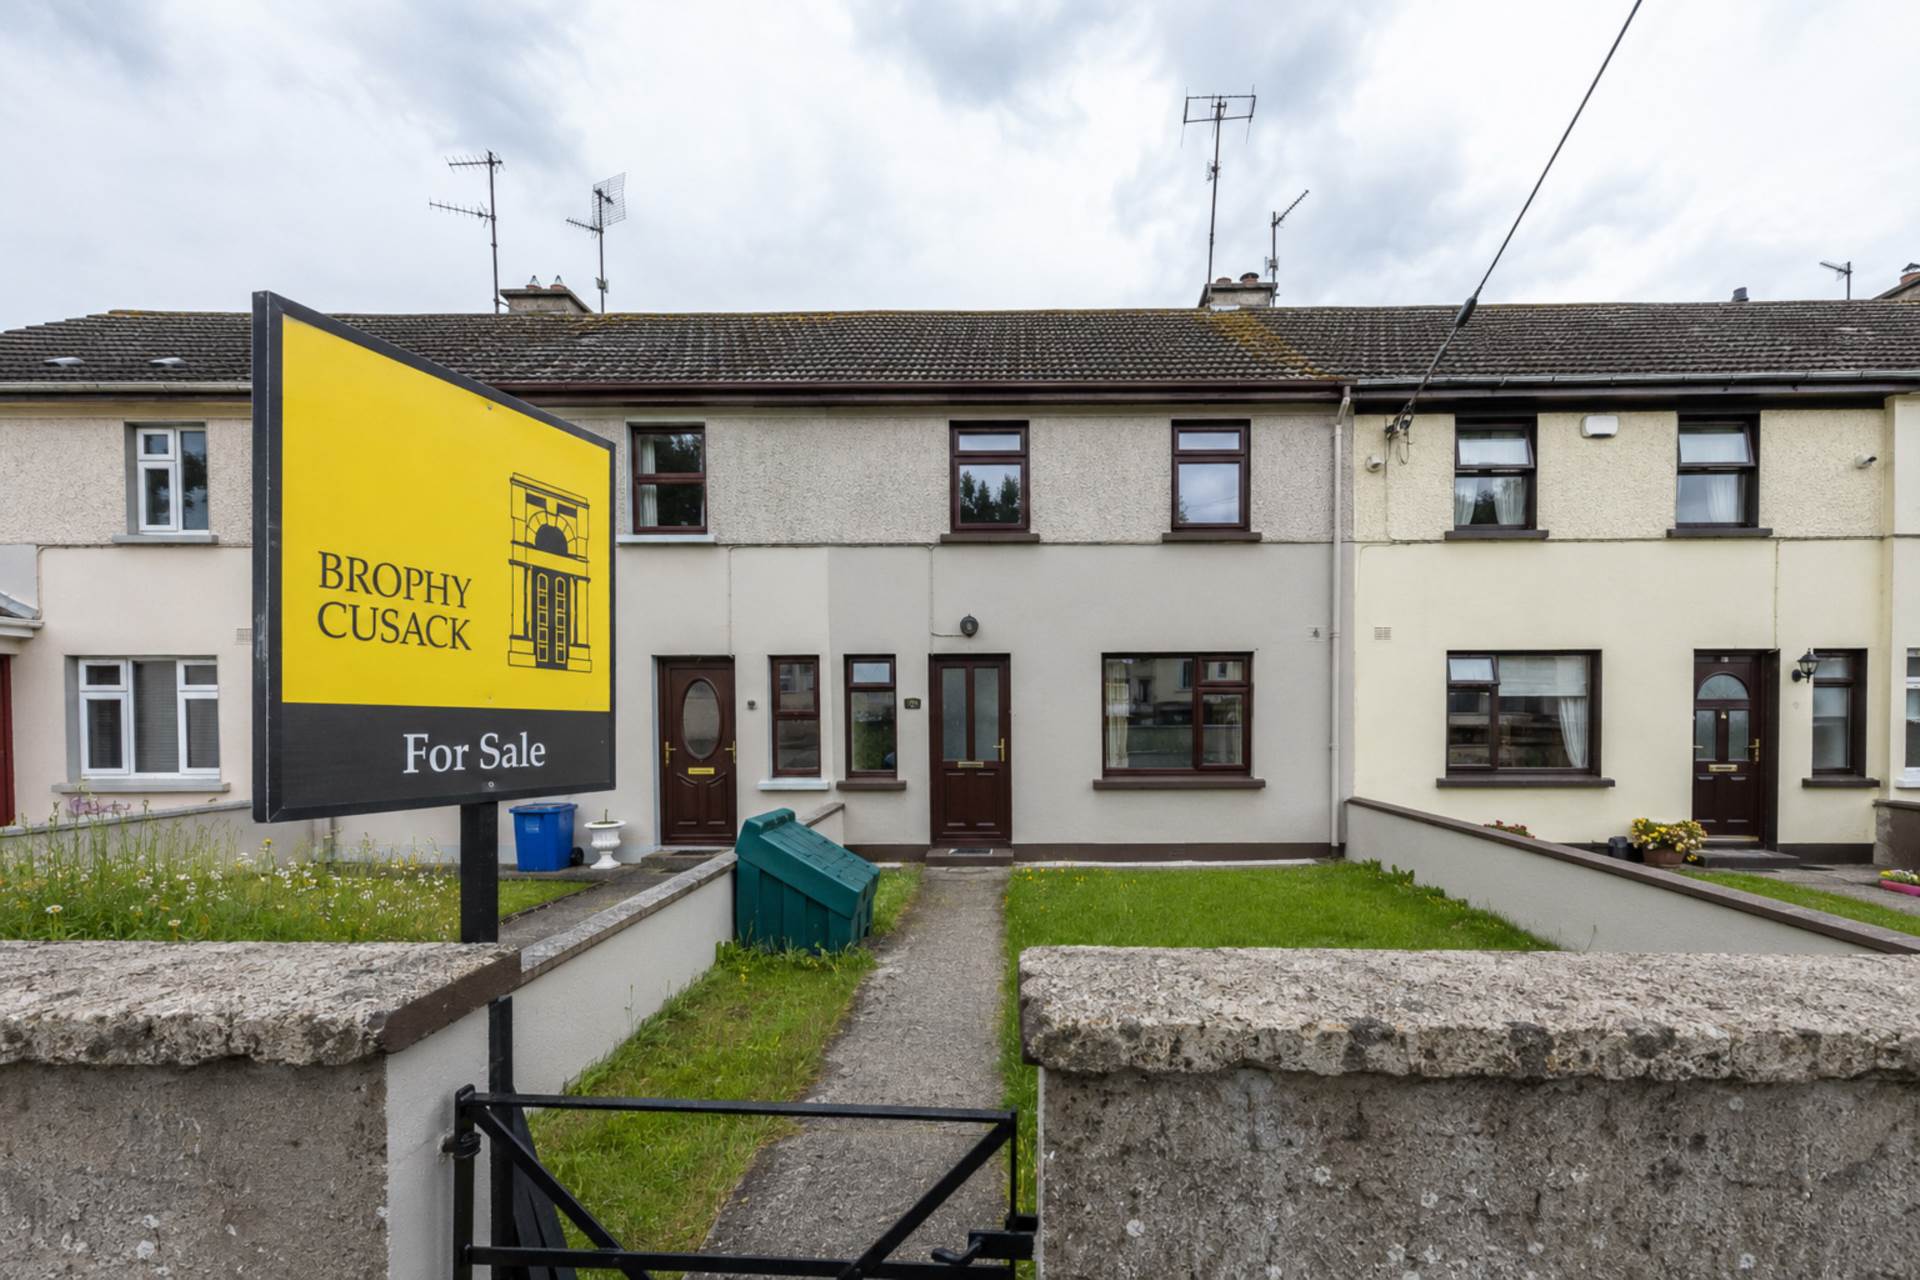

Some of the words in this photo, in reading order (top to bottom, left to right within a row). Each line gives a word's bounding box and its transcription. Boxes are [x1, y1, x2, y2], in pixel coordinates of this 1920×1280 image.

[318, 551, 472, 609] BROPHY
[317, 601, 472, 651] CUSACK
[402, 733, 470, 774] For
[479, 731, 546, 769] Sale
